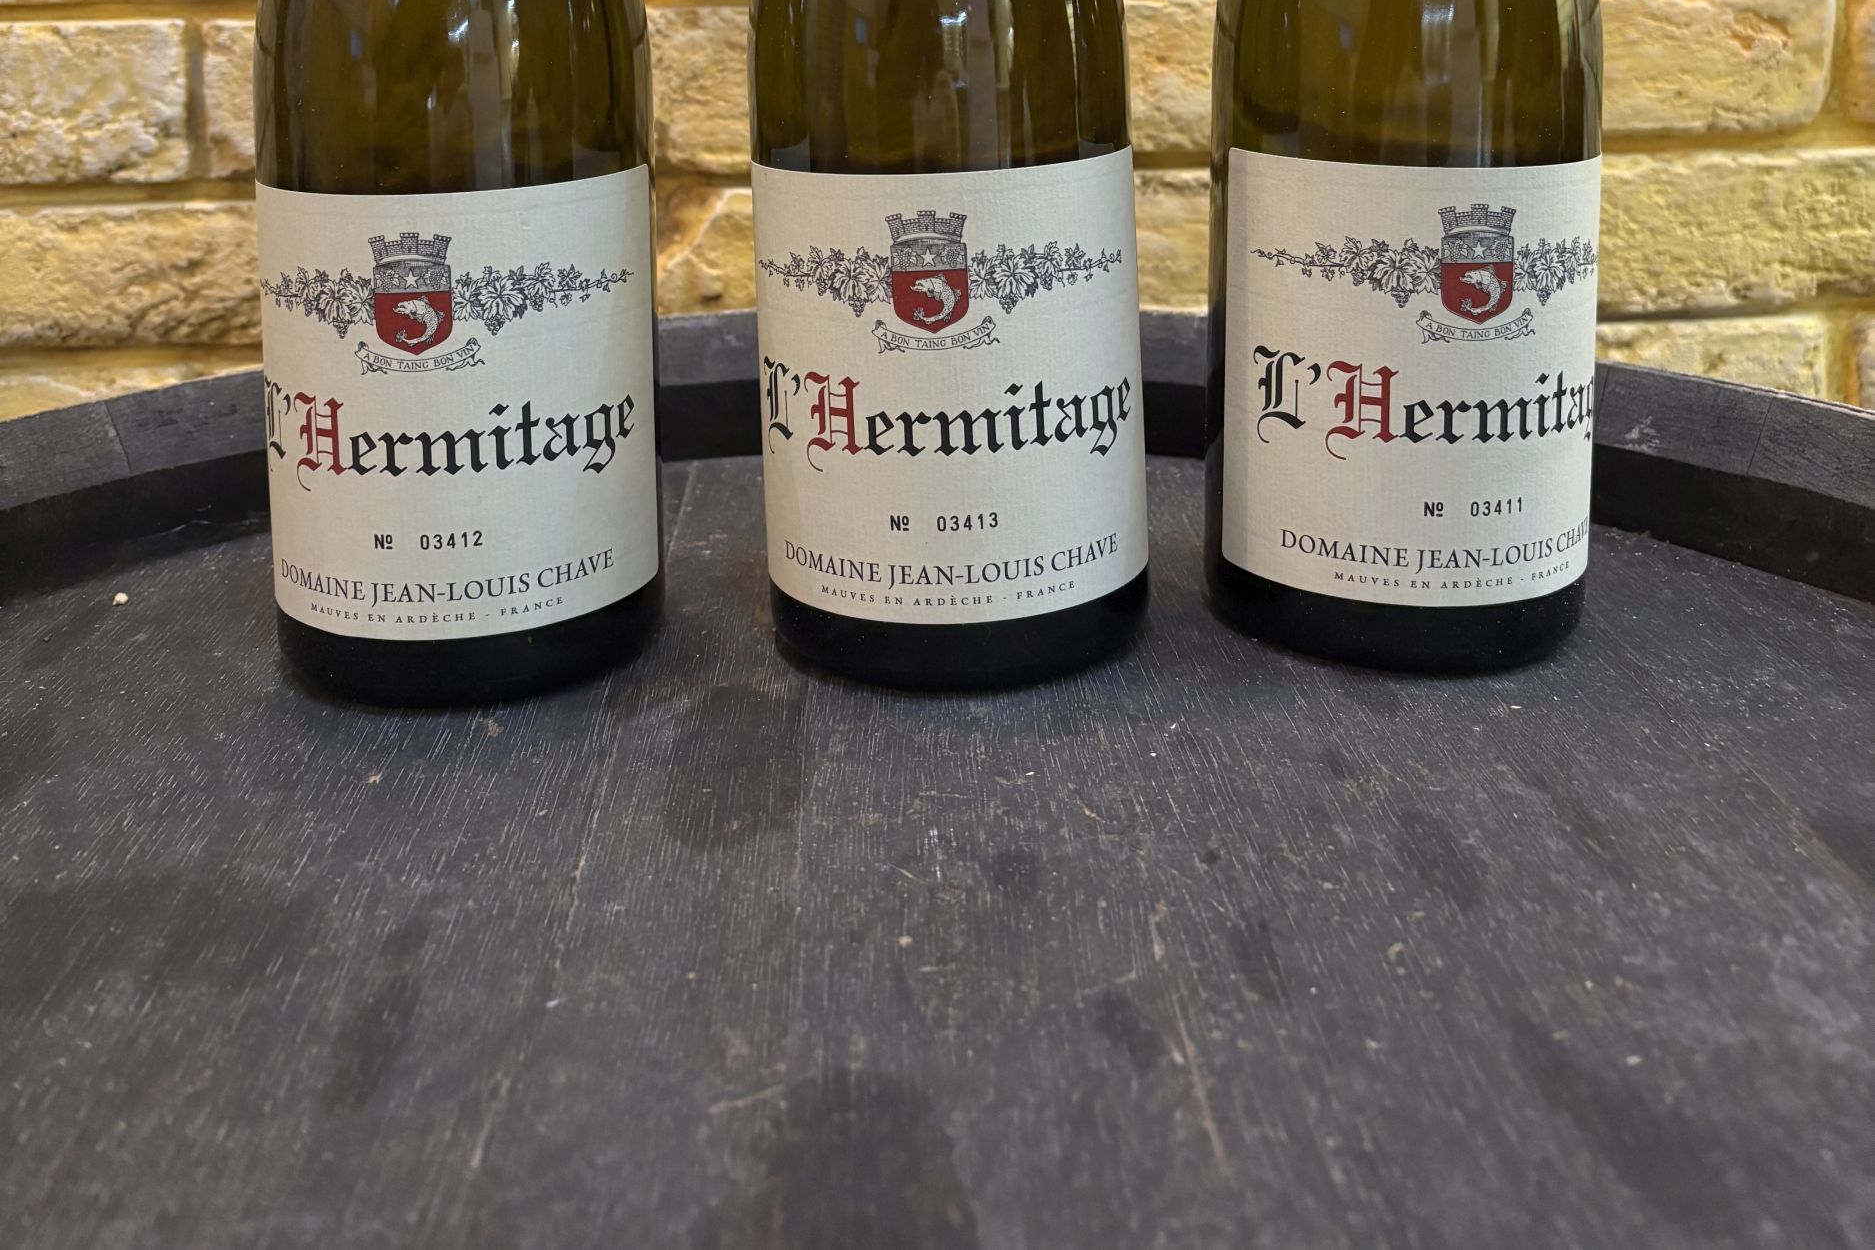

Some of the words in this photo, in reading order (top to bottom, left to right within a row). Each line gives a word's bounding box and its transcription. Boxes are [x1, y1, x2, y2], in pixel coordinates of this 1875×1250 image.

[890, 333, 910, 346] BON
[915, 339, 946, 348] TAING
[951, 333, 971, 346] BON
[973, 323, 990, 336] VIN
[1435, 324, 1456, 336] BON
[1461, 331, 1490, 339] TAING
[1494, 324, 1512, 336] BON
[1514, 314, 1529, 327] VIN
[373, 355, 392, 367] BON
[397, 361, 429, 370] TAING
[434, 354, 454, 366] BON
[456, 345, 475, 358] VIN
[763, 356, 1132, 473] L'Hermitage
[265, 375, 636, 492] L'Hermitage
[1470, 497, 1523, 517] 03411
[936, 512, 1000, 532] 03413
[419, 530, 484, 550] 03412
[1279, 528, 1410, 568] DOMAINE
[1416, 538, 1553, 574] JEAN-LOUIS
[784, 539, 883, 583] DOMAINE
[888, 555, 1045, 590] JEAN-LOUIS
[1050, 532, 1120, 572] CHAVE
[280, 557, 366, 602] DOMAINE
[371, 572, 531, 607] JEAN-LOUIS
[537, 548, 615, 588] CHAVE
[1333, 571, 1400, 587] MAUVES
[1410, 580, 1431, 589] EN
[1440, 576, 1513, 589] ARDÈCHE
[1531, 561, 1570, 581] FRANCE
[821, 584, 876, 603] MAUVES
[884, 596, 903, 606] EN
[912, 594, 994, 606] ARDÈCHE
[1016, 580, 1076, 601] FRANCE
[311, 602, 359, 621] MAUVES
[368, 613, 385, 622] EN
[396, 611, 476, 623] ARDÈCHE
[500, 595, 565, 616] FRANCE
